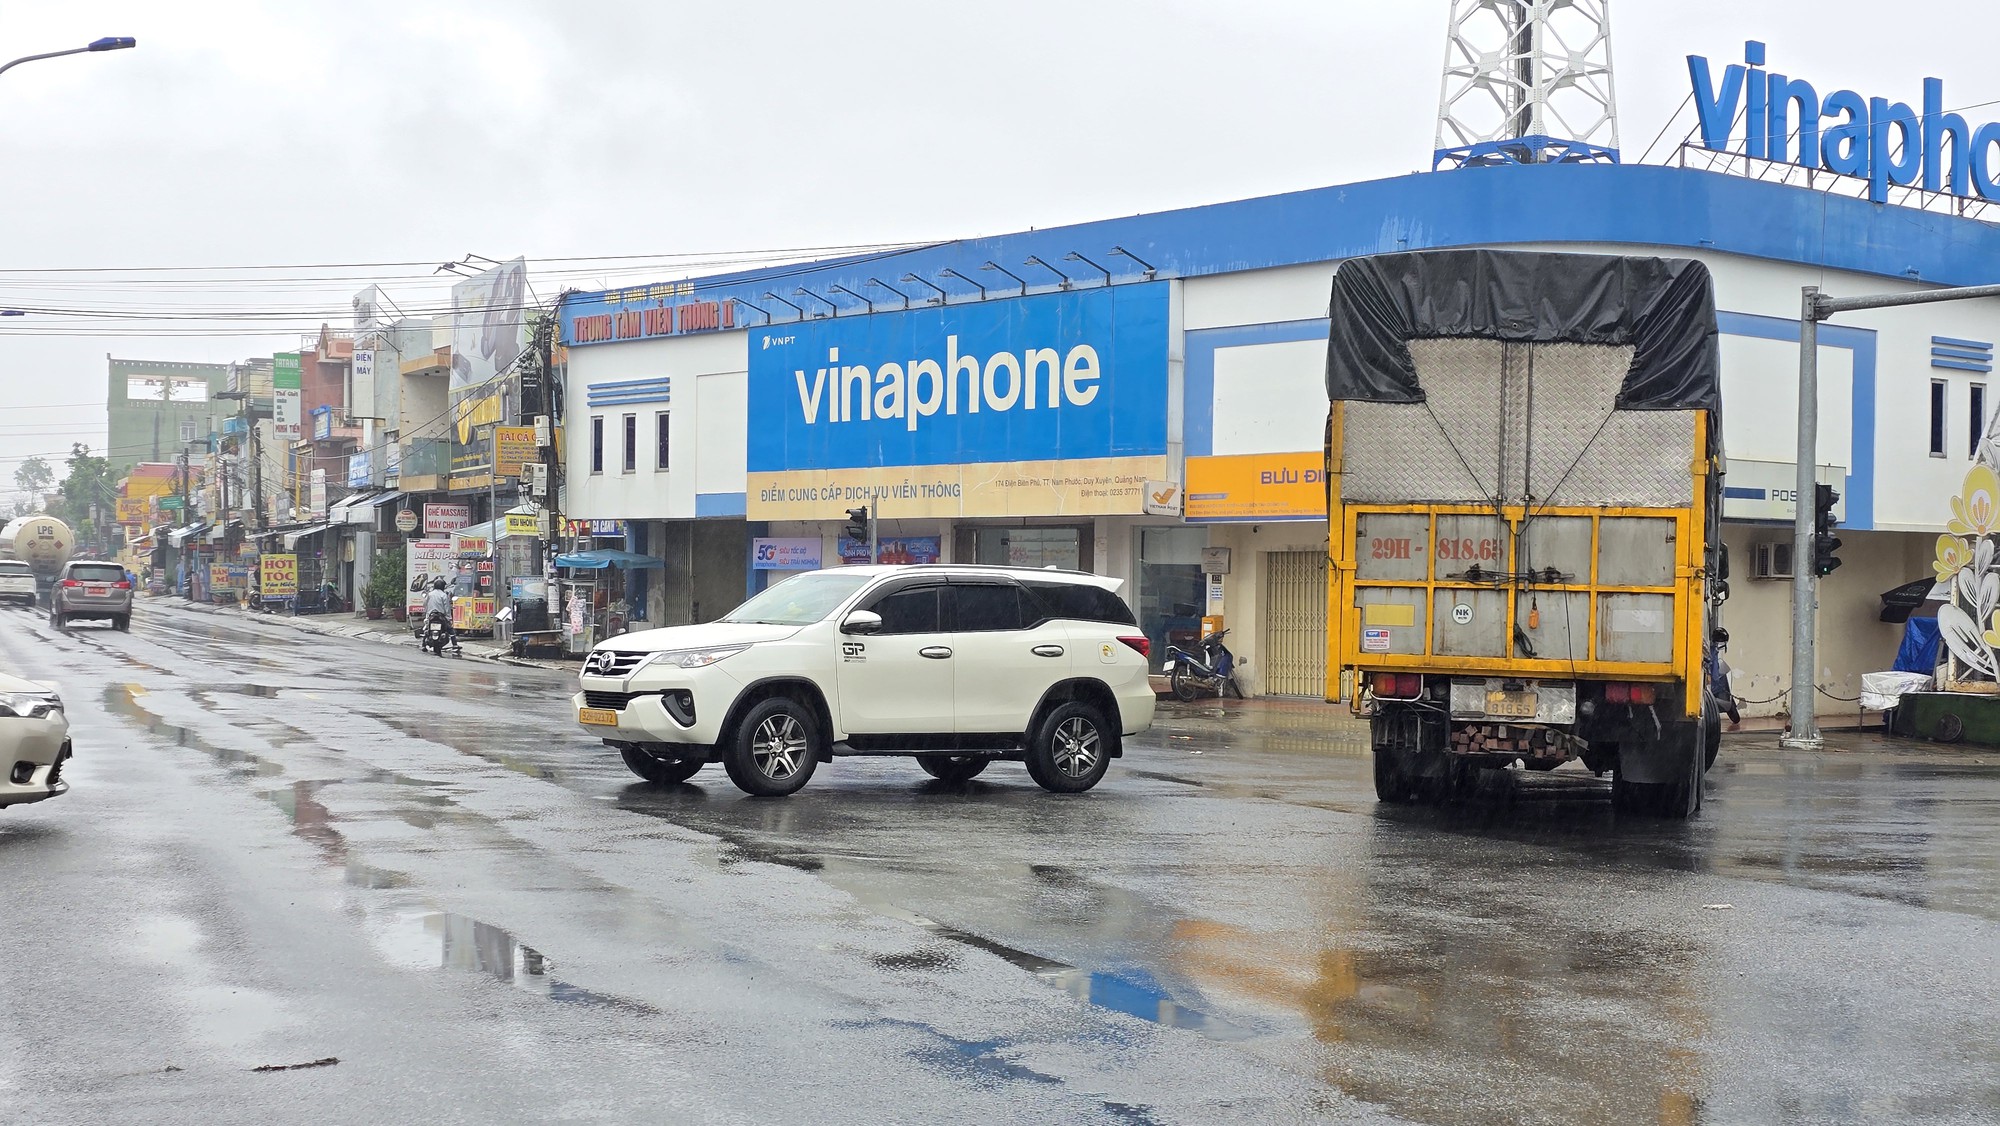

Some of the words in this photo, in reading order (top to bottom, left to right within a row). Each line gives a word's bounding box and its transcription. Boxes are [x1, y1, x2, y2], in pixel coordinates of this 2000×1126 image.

[573, 314, 612, 342] TRUNG
[614, 308, 641, 340] TÂM
[676, 298, 719, 332] THÔNG
[772, 336, 795, 346] VNPT
[356, 364, 371, 375] MÁY
[795, 334, 1100, 432] vinaphone
[1260, 467, 1298, 484] BƯU
[1084, 478, 1094, 486] Duy
[761, 482, 785, 501] ĐIỂM
[788, 487, 818, 501] CUNG
[821, 481, 842, 500] CẤP
[846, 486, 870, 502] DỊCH
[874, 485, 888, 501] VỤ
[892, 478, 917, 498] VIỄN
[921, 480, 960, 498] THÔNG
[441, 508, 468, 516] MASSAGE
[428, 520, 441, 528] MÁY
[37, 526, 53, 535] LPG
[1372, 538, 1411, 559] 29H
[265, 558, 294, 569] HỚT
